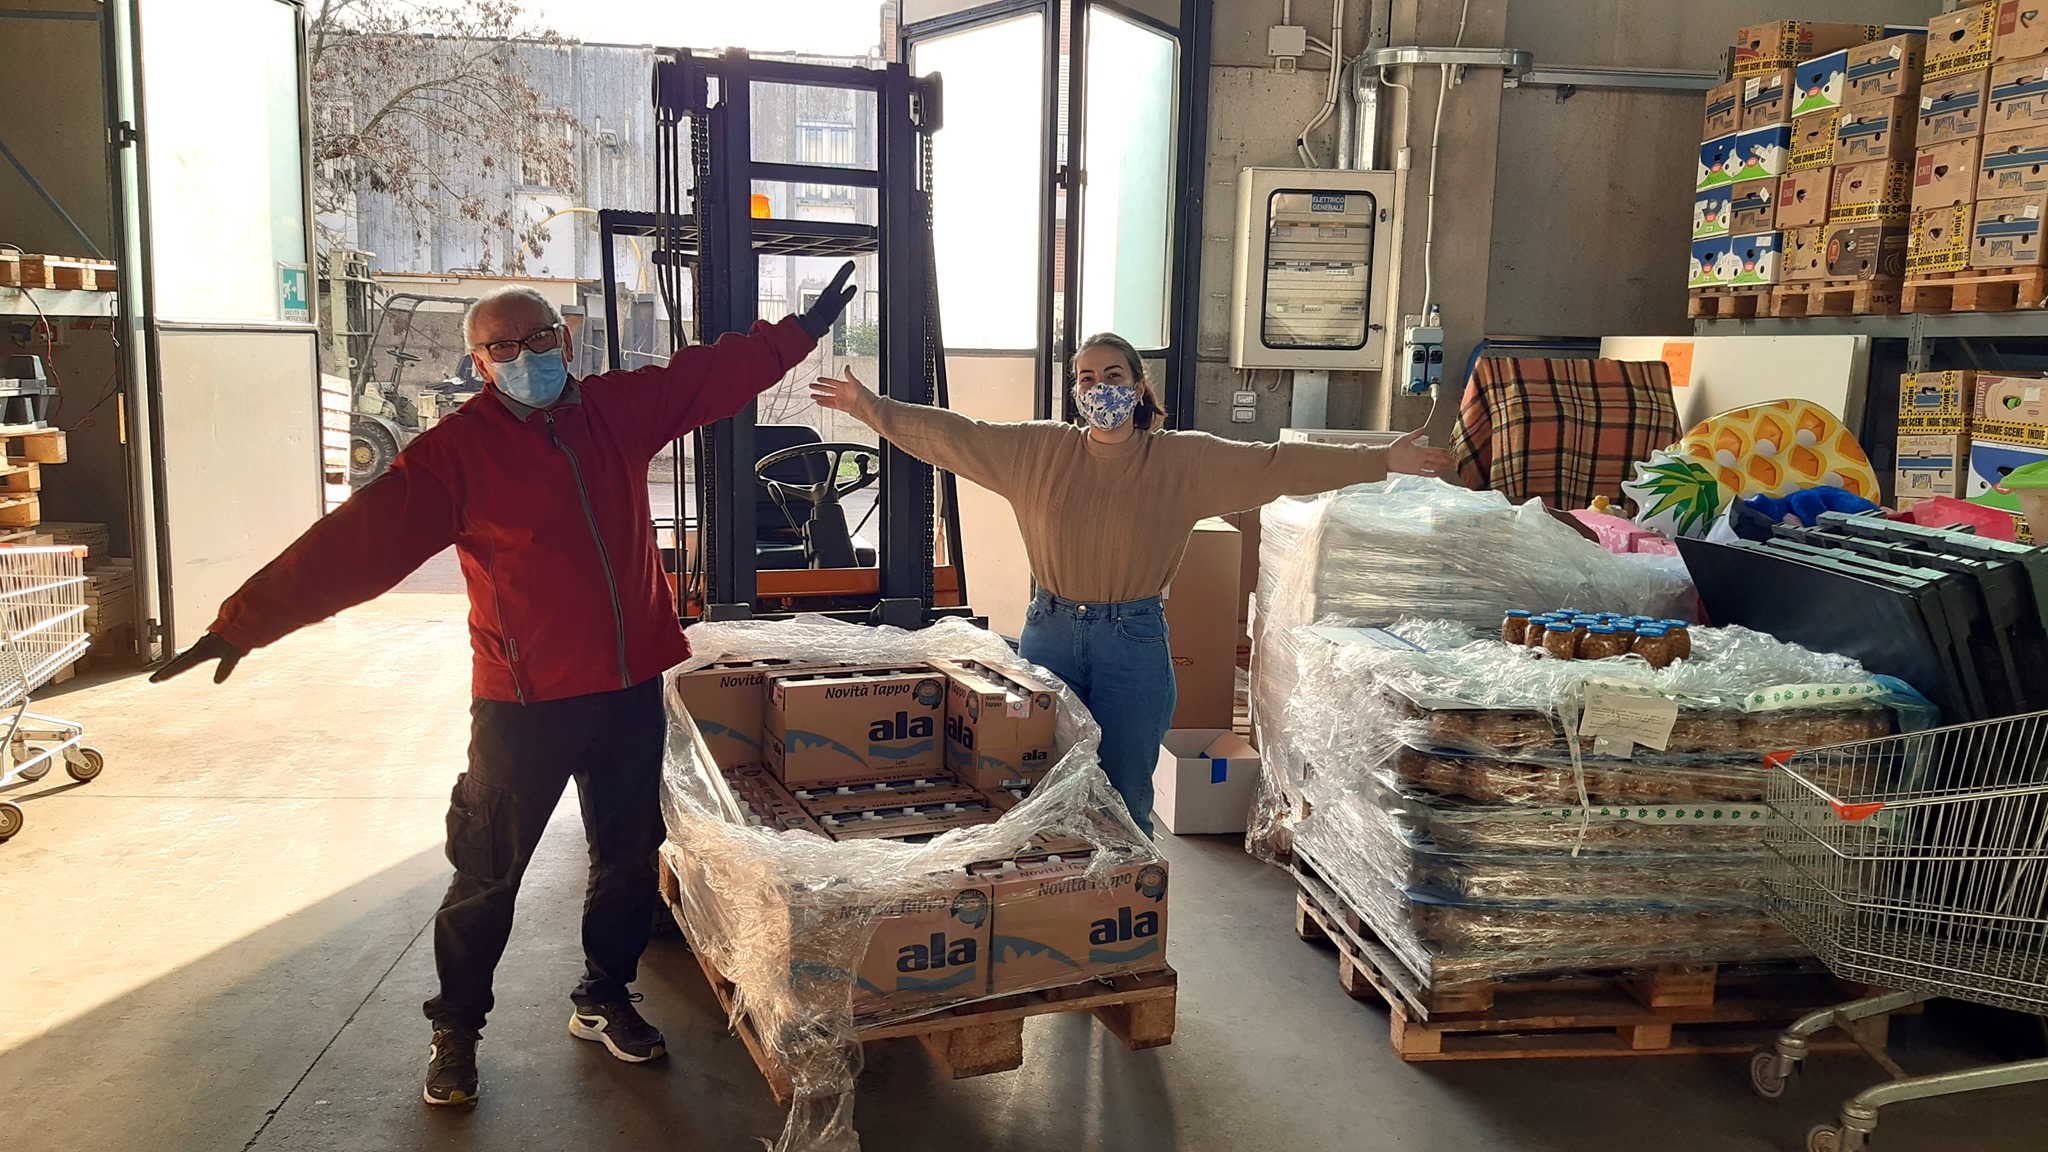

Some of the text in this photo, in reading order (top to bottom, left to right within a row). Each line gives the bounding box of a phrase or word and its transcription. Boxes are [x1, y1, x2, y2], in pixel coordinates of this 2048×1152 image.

[1982, 11, 1990, 34] INDIE
[1785, 37, 1795, 56] INDIE
[1953, 55, 1971, 67] CRIME
[1972, 51, 1992, 63] SCENE
[2007, 101, 2031, 120] BONITA
[1892, 177, 1903, 201] SCEN
[1998, 171, 2022, 189] BONITA
[1312, 203, 1344, 211] GENERALE
[1953, 214, 1962, 237] INDIE
[1990, 240, 2013, 257] BONITA
[1934, 253, 1950, 264] SCENE
[1976, 381, 1987, 416] EMIUM
[1984, 424, 2003, 436] CRIME
[2004, 426, 2025, 438] SCENE
[2027, 429, 2046, 440] INDIE
[1911, 473, 1932, 488] BONITA
[720, 673, 764, 688] Novità
[825, 683, 910, 699] Novità Tappo
[951, 681, 967, 699] Tappo
[868, 711, 934, 741] ala
[947, 714, 974, 751] ala
[1022, 749, 1048, 760] ala
[1090, 872, 1132, 890] Tppo
[1088, 907, 1159, 945] ala
[896, 932, 978, 973] ala
